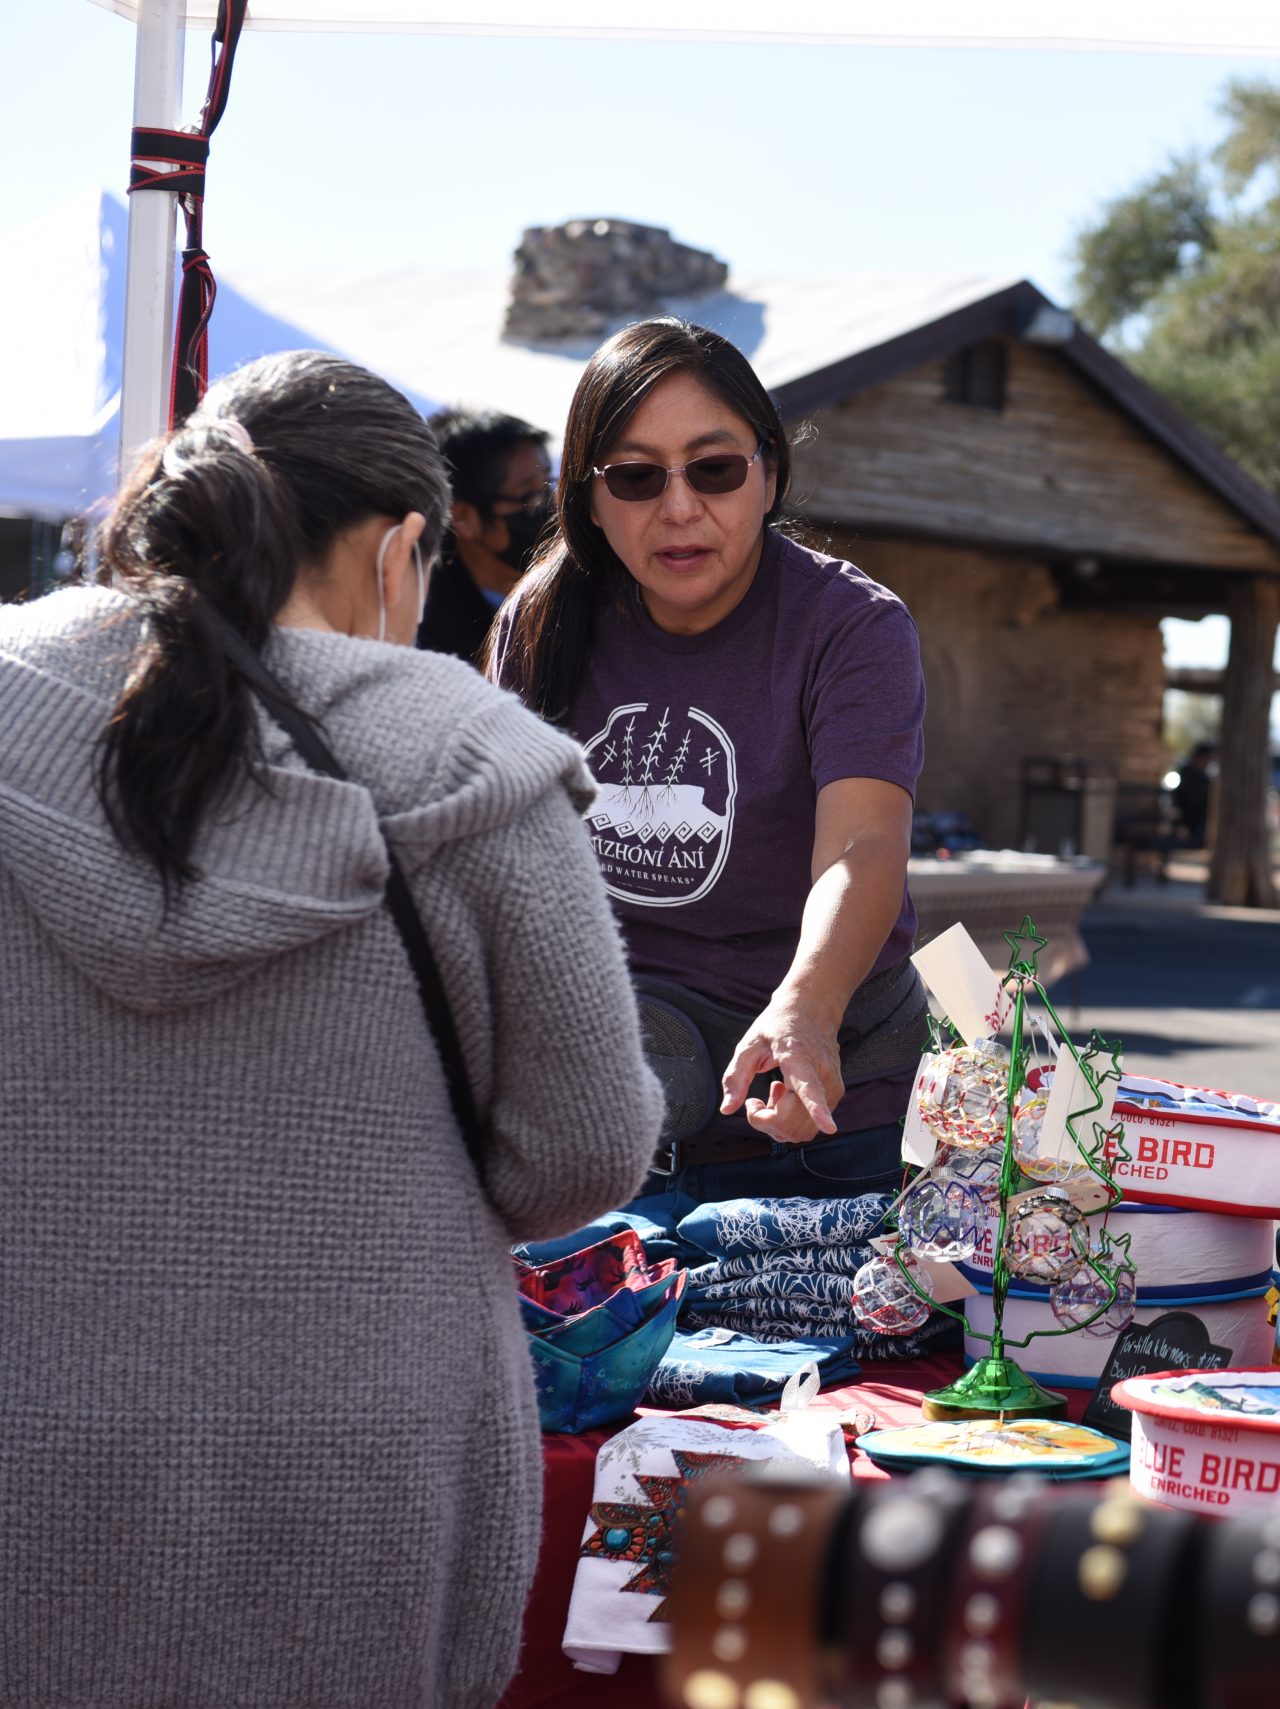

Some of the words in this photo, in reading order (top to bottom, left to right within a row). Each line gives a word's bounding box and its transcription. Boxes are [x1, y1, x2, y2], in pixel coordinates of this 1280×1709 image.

[668, 845, 705, 869] ÁNÍ
[616, 866, 649, 880] WATER
[1136, 1136, 1215, 1169] BIRD
[1151, 1476, 1231, 1505] ENRICHED
